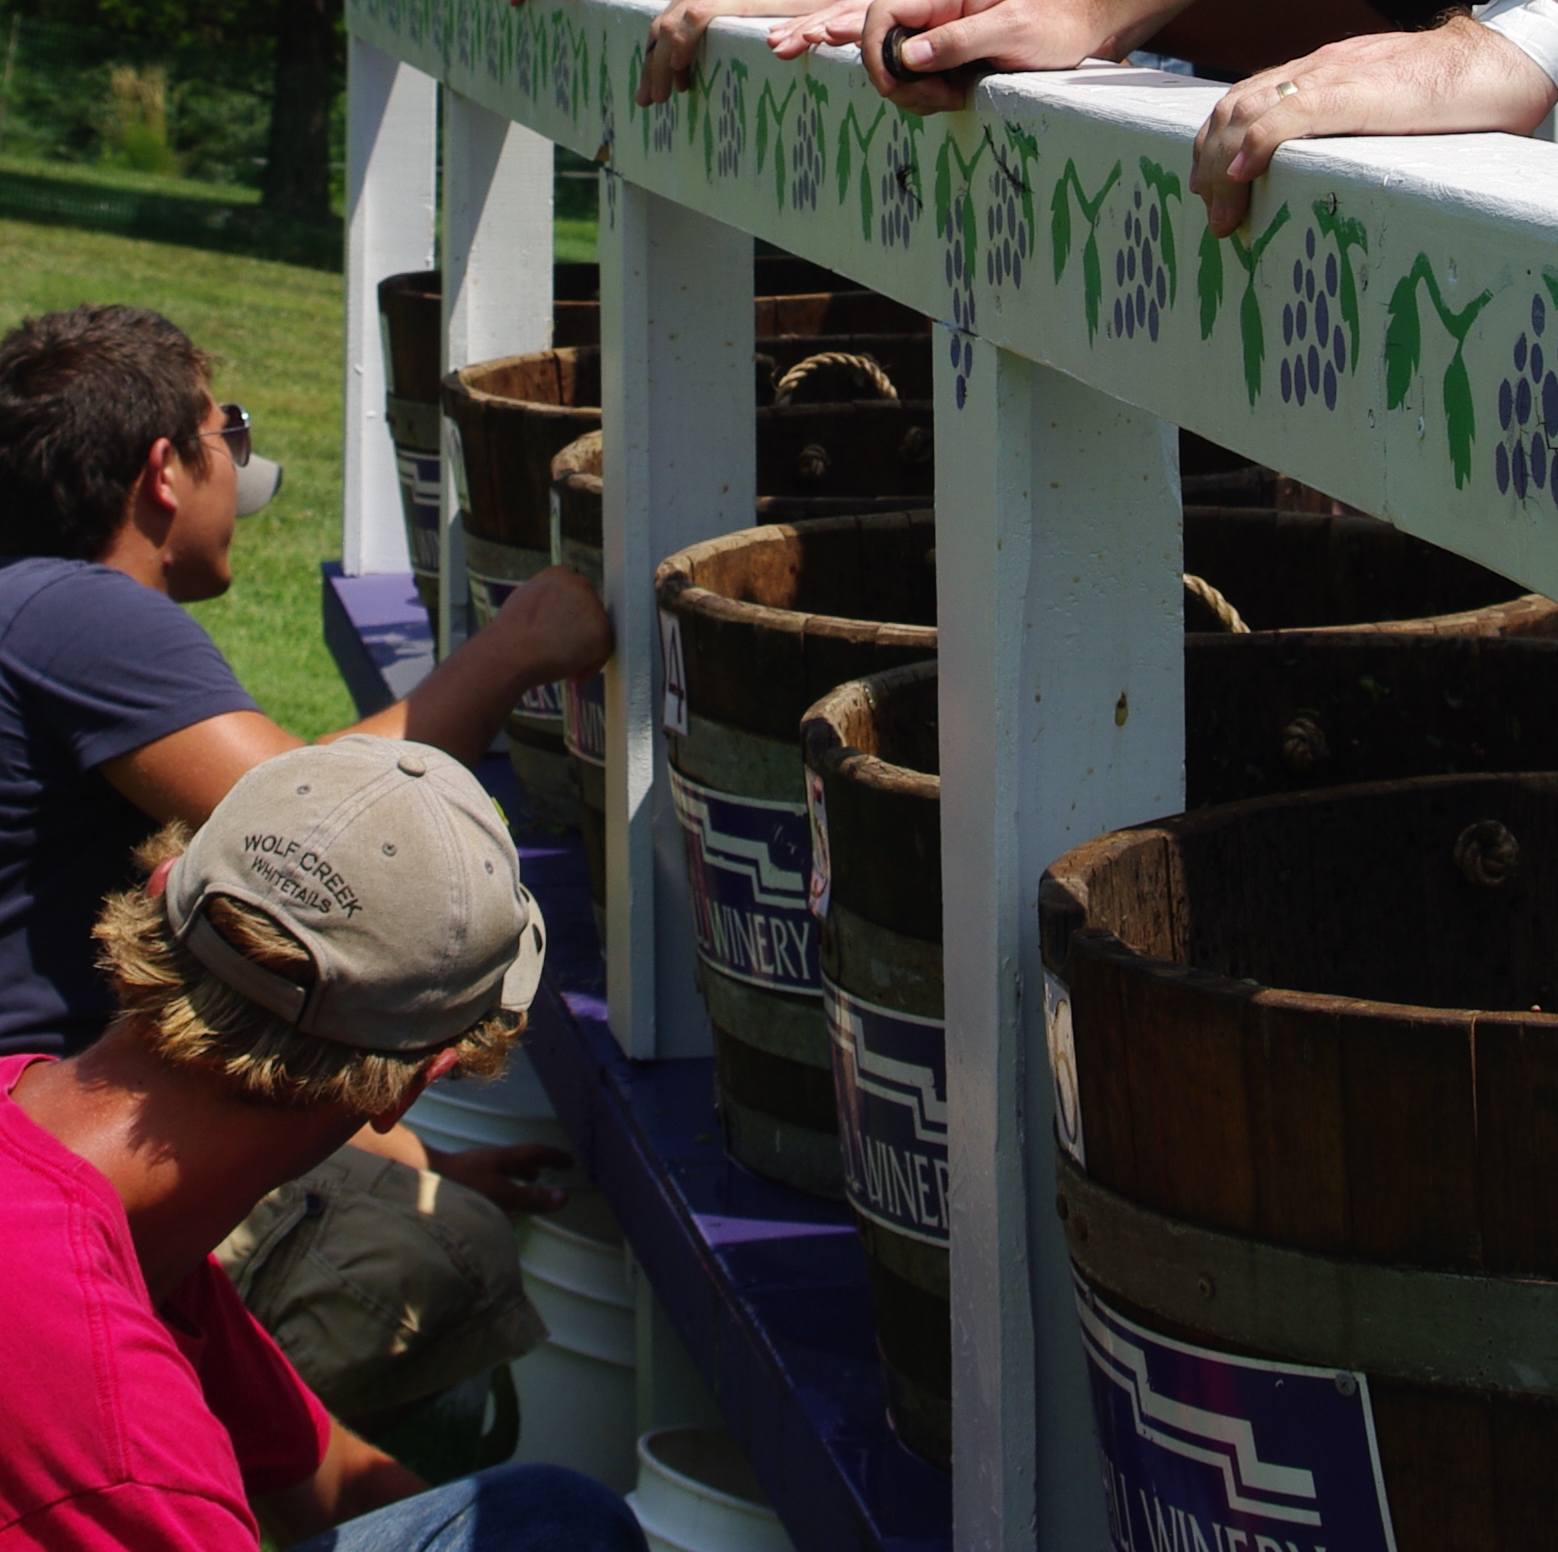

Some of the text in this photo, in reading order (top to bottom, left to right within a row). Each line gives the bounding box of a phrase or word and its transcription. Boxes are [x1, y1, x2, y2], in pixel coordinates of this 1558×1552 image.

[244, 834, 363, 919] WOLF CREEK
[251, 856, 332, 914] WHITETAILS
[706, 897, 811, 980] WINERY
[856, 1128, 950, 1230] WINER
